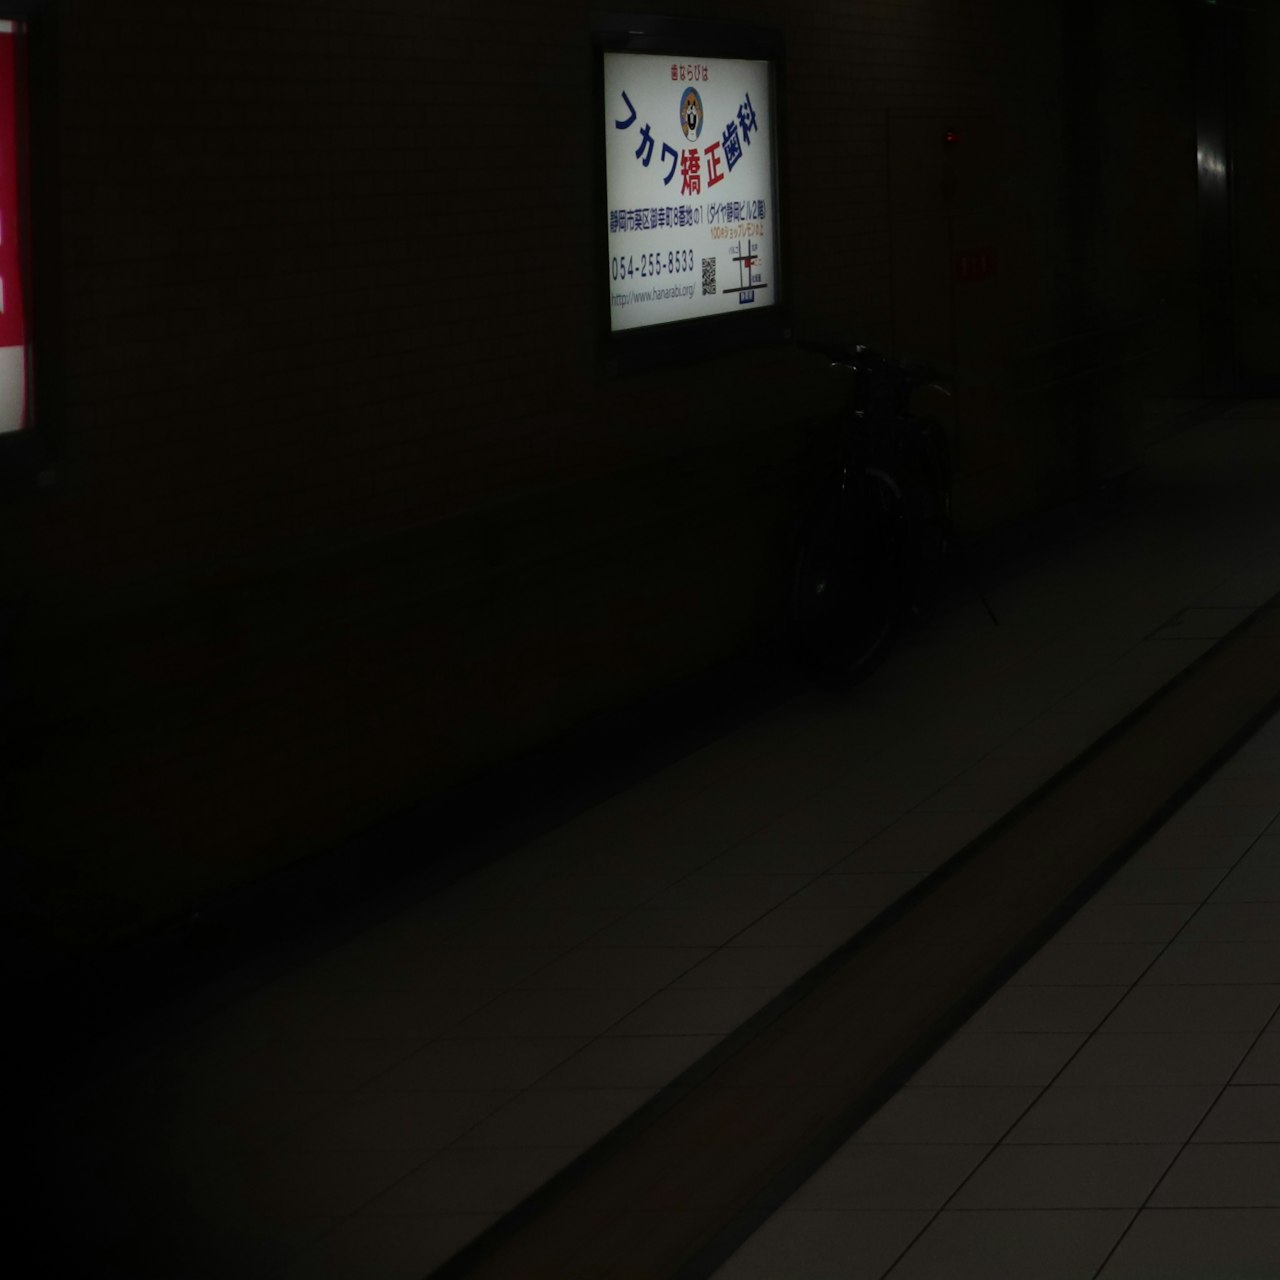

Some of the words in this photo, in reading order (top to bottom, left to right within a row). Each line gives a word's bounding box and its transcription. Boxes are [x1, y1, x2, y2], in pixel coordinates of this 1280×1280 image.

[671, 63, 709, 81] 歯ならびは
[611, 249, 694, 281] 054-255-8533
